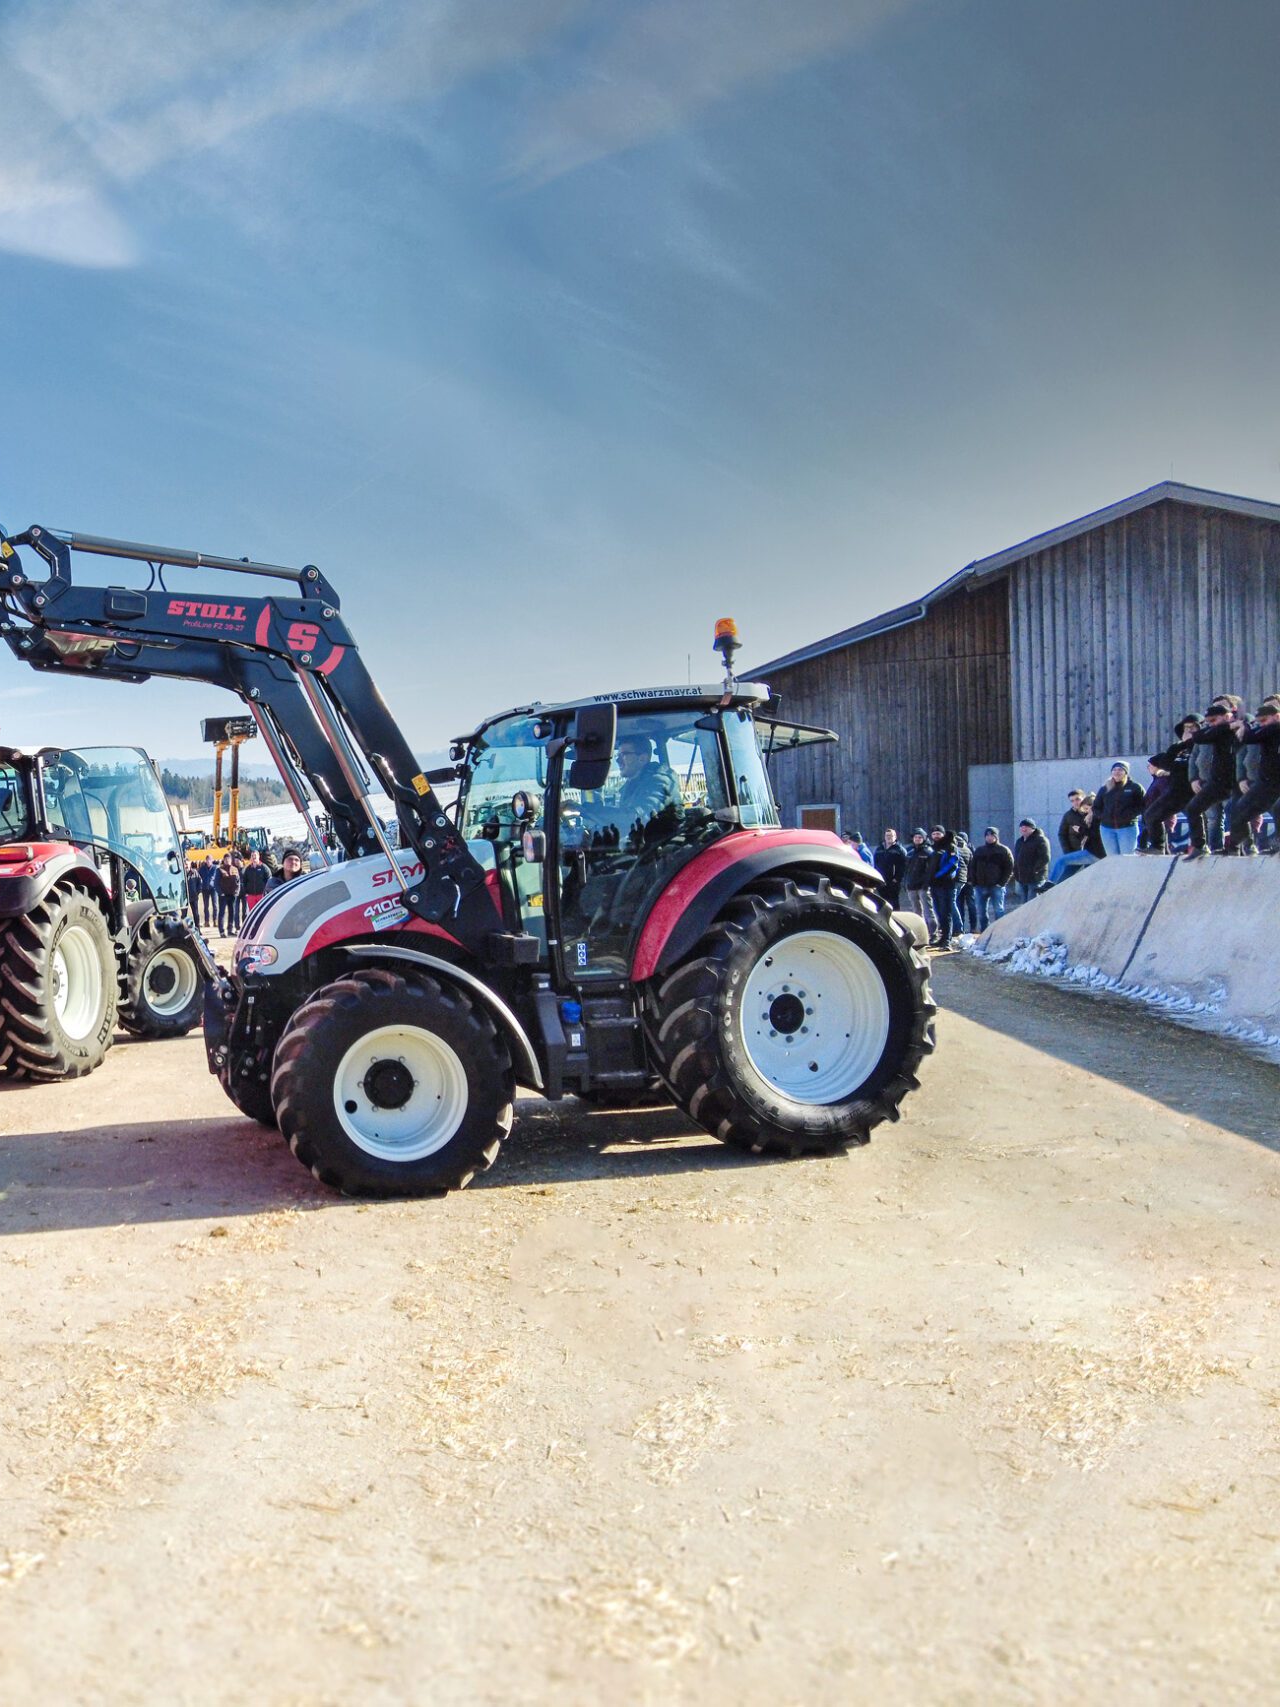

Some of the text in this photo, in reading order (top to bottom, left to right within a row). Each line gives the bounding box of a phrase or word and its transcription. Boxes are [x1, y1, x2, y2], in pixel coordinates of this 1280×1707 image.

[167, 600, 246, 621] STOLL
[287, 623, 320, 651] S
[593, 686, 703, 702] www.schwarzmayr.at
